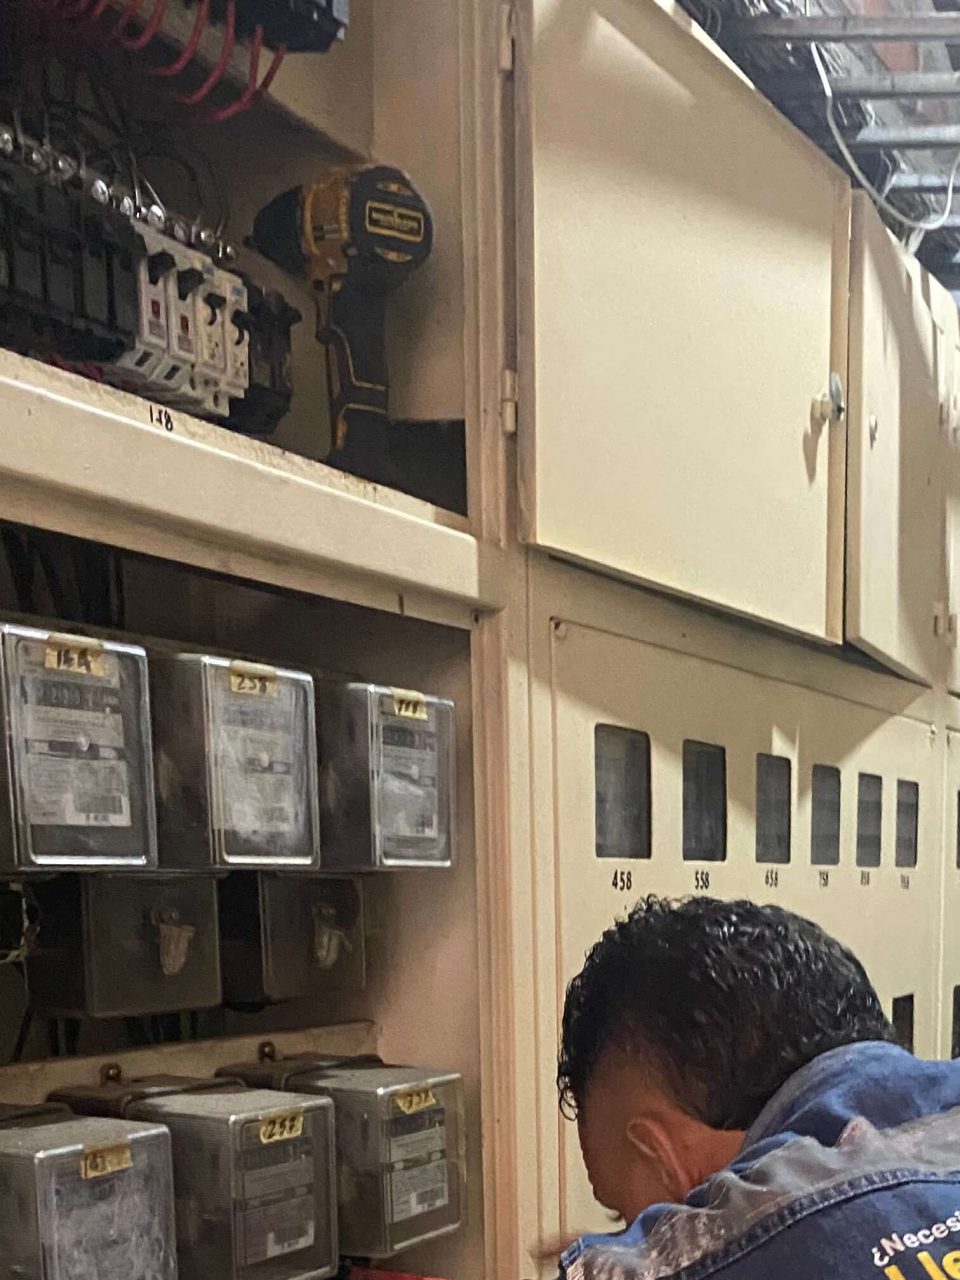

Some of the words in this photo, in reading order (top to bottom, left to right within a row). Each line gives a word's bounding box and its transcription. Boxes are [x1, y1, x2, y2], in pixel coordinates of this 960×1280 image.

[612, 869, 633, 891] 458
[695, 870, 710, 890] 558
[765, 870, 779, 888] 658
